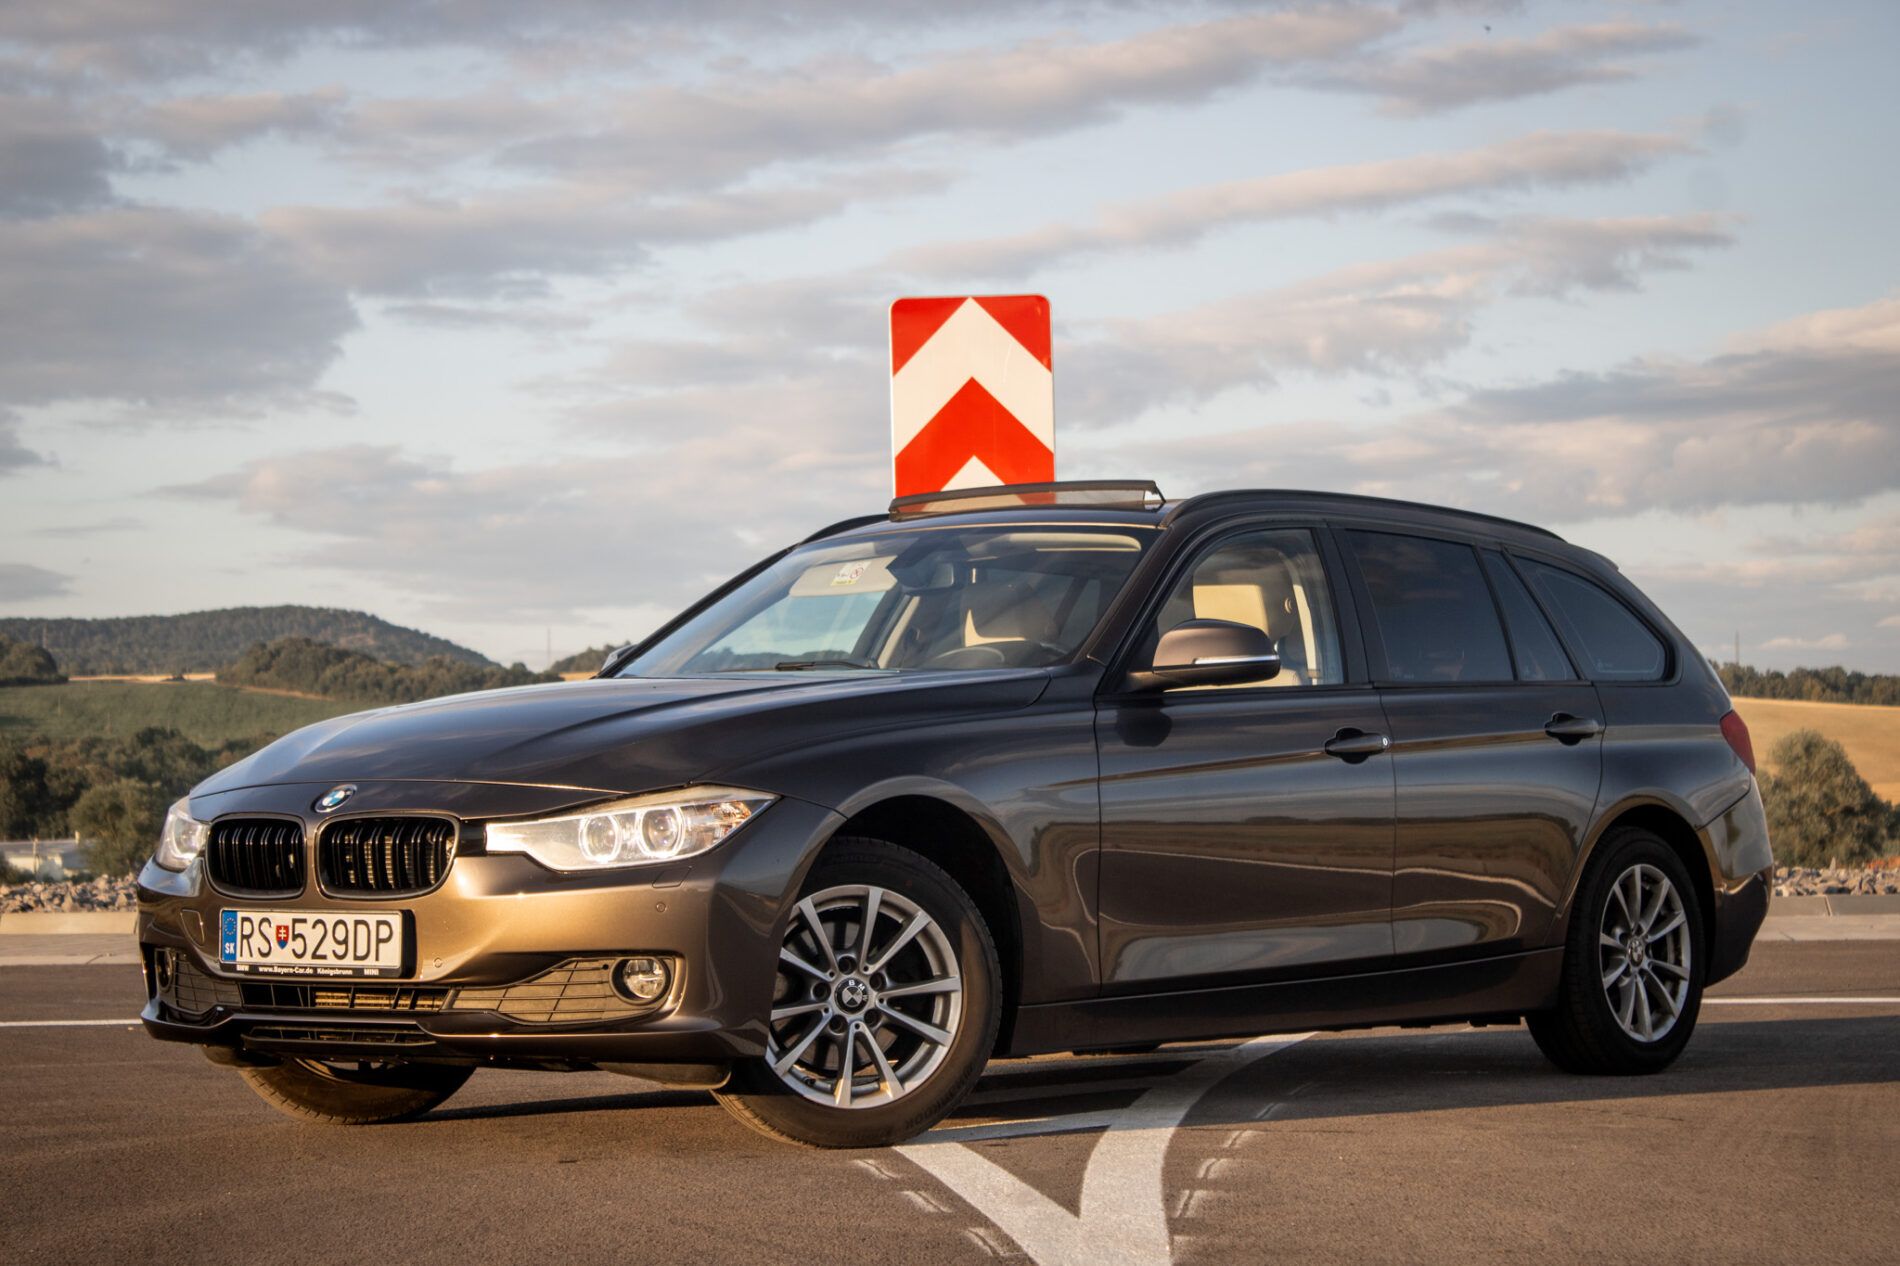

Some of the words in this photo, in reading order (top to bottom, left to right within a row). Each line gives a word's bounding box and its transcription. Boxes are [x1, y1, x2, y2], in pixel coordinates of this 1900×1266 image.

[240, 916, 272, 958] RS
[291, 918, 394, 961] 529DP
[225, 942, 235, 955] SK
[363, 968, 379, 976] MINI
